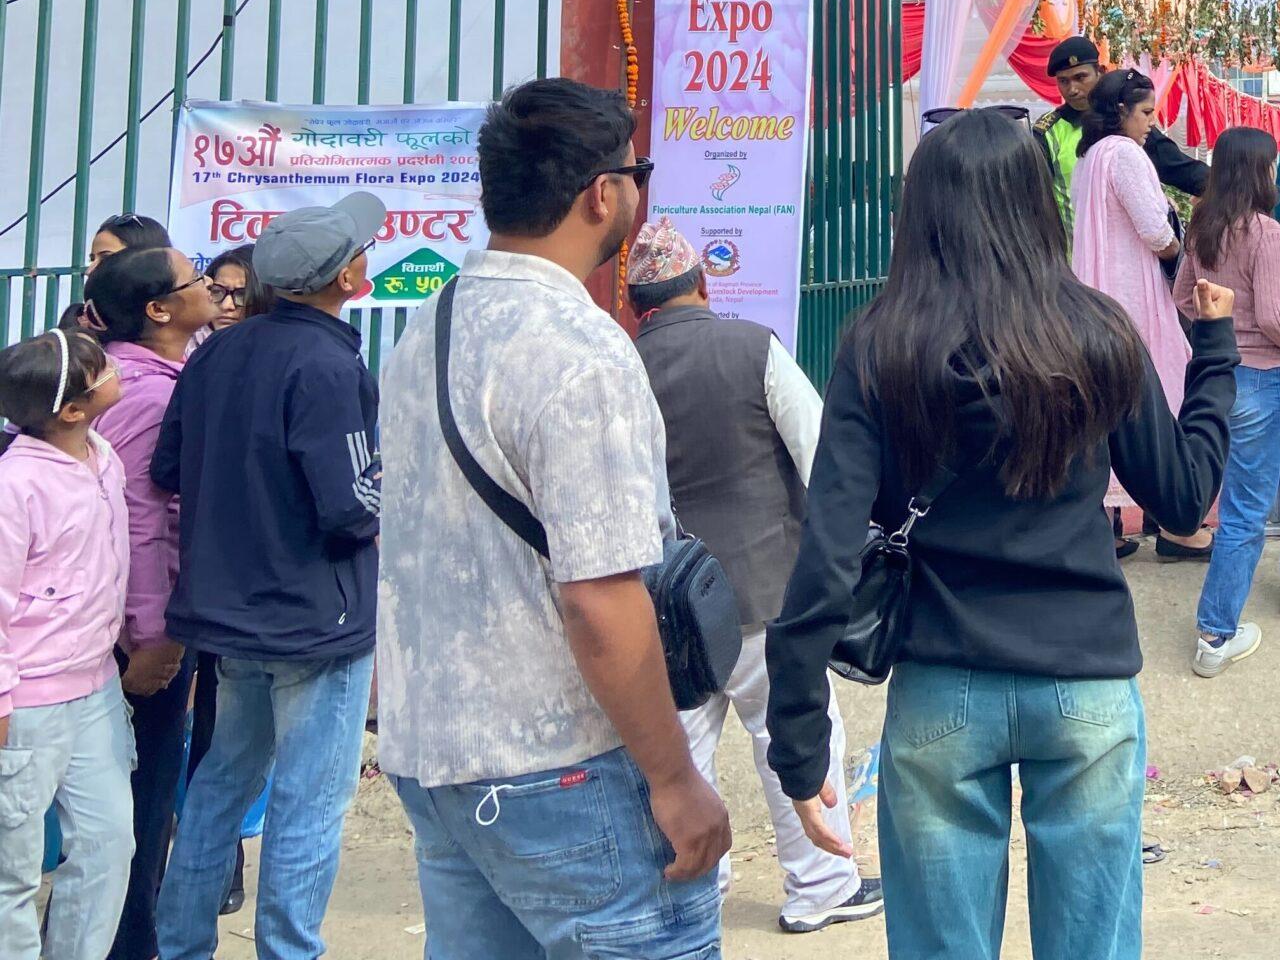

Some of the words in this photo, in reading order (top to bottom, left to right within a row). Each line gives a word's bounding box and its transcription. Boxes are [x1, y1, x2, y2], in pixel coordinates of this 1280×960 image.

[683, 45, 772, 92] 2024
[663, 106, 796, 141] Welcome
[291, 127, 388, 148] गोदावरी
[395, 126, 473, 150] फूलको
[289, 153, 391, 167] प्रतियोगितात्मक
[397, 152, 444, 167] प्रदर्शनी
[704, 150, 738, 159] Organized
[739, 150, 748, 159] by
[227, 172, 349, 186] Chrysanthemum
[355, 172, 394, 184] Flora
[400, 172, 435, 185] Expo
[441, 171, 480, 183] 2024
[652, 205, 698, 214] Floriculture
[699, 205, 746, 214] Association
[748, 205, 771, 216] Nepal
[773, 205, 796, 216] (FAN)
[700, 227, 733, 237] Supported
[735, 227, 743, 236] by
[401, 261, 446, 273] विद्यार्थी
[737, 288, 779, 297] Development
